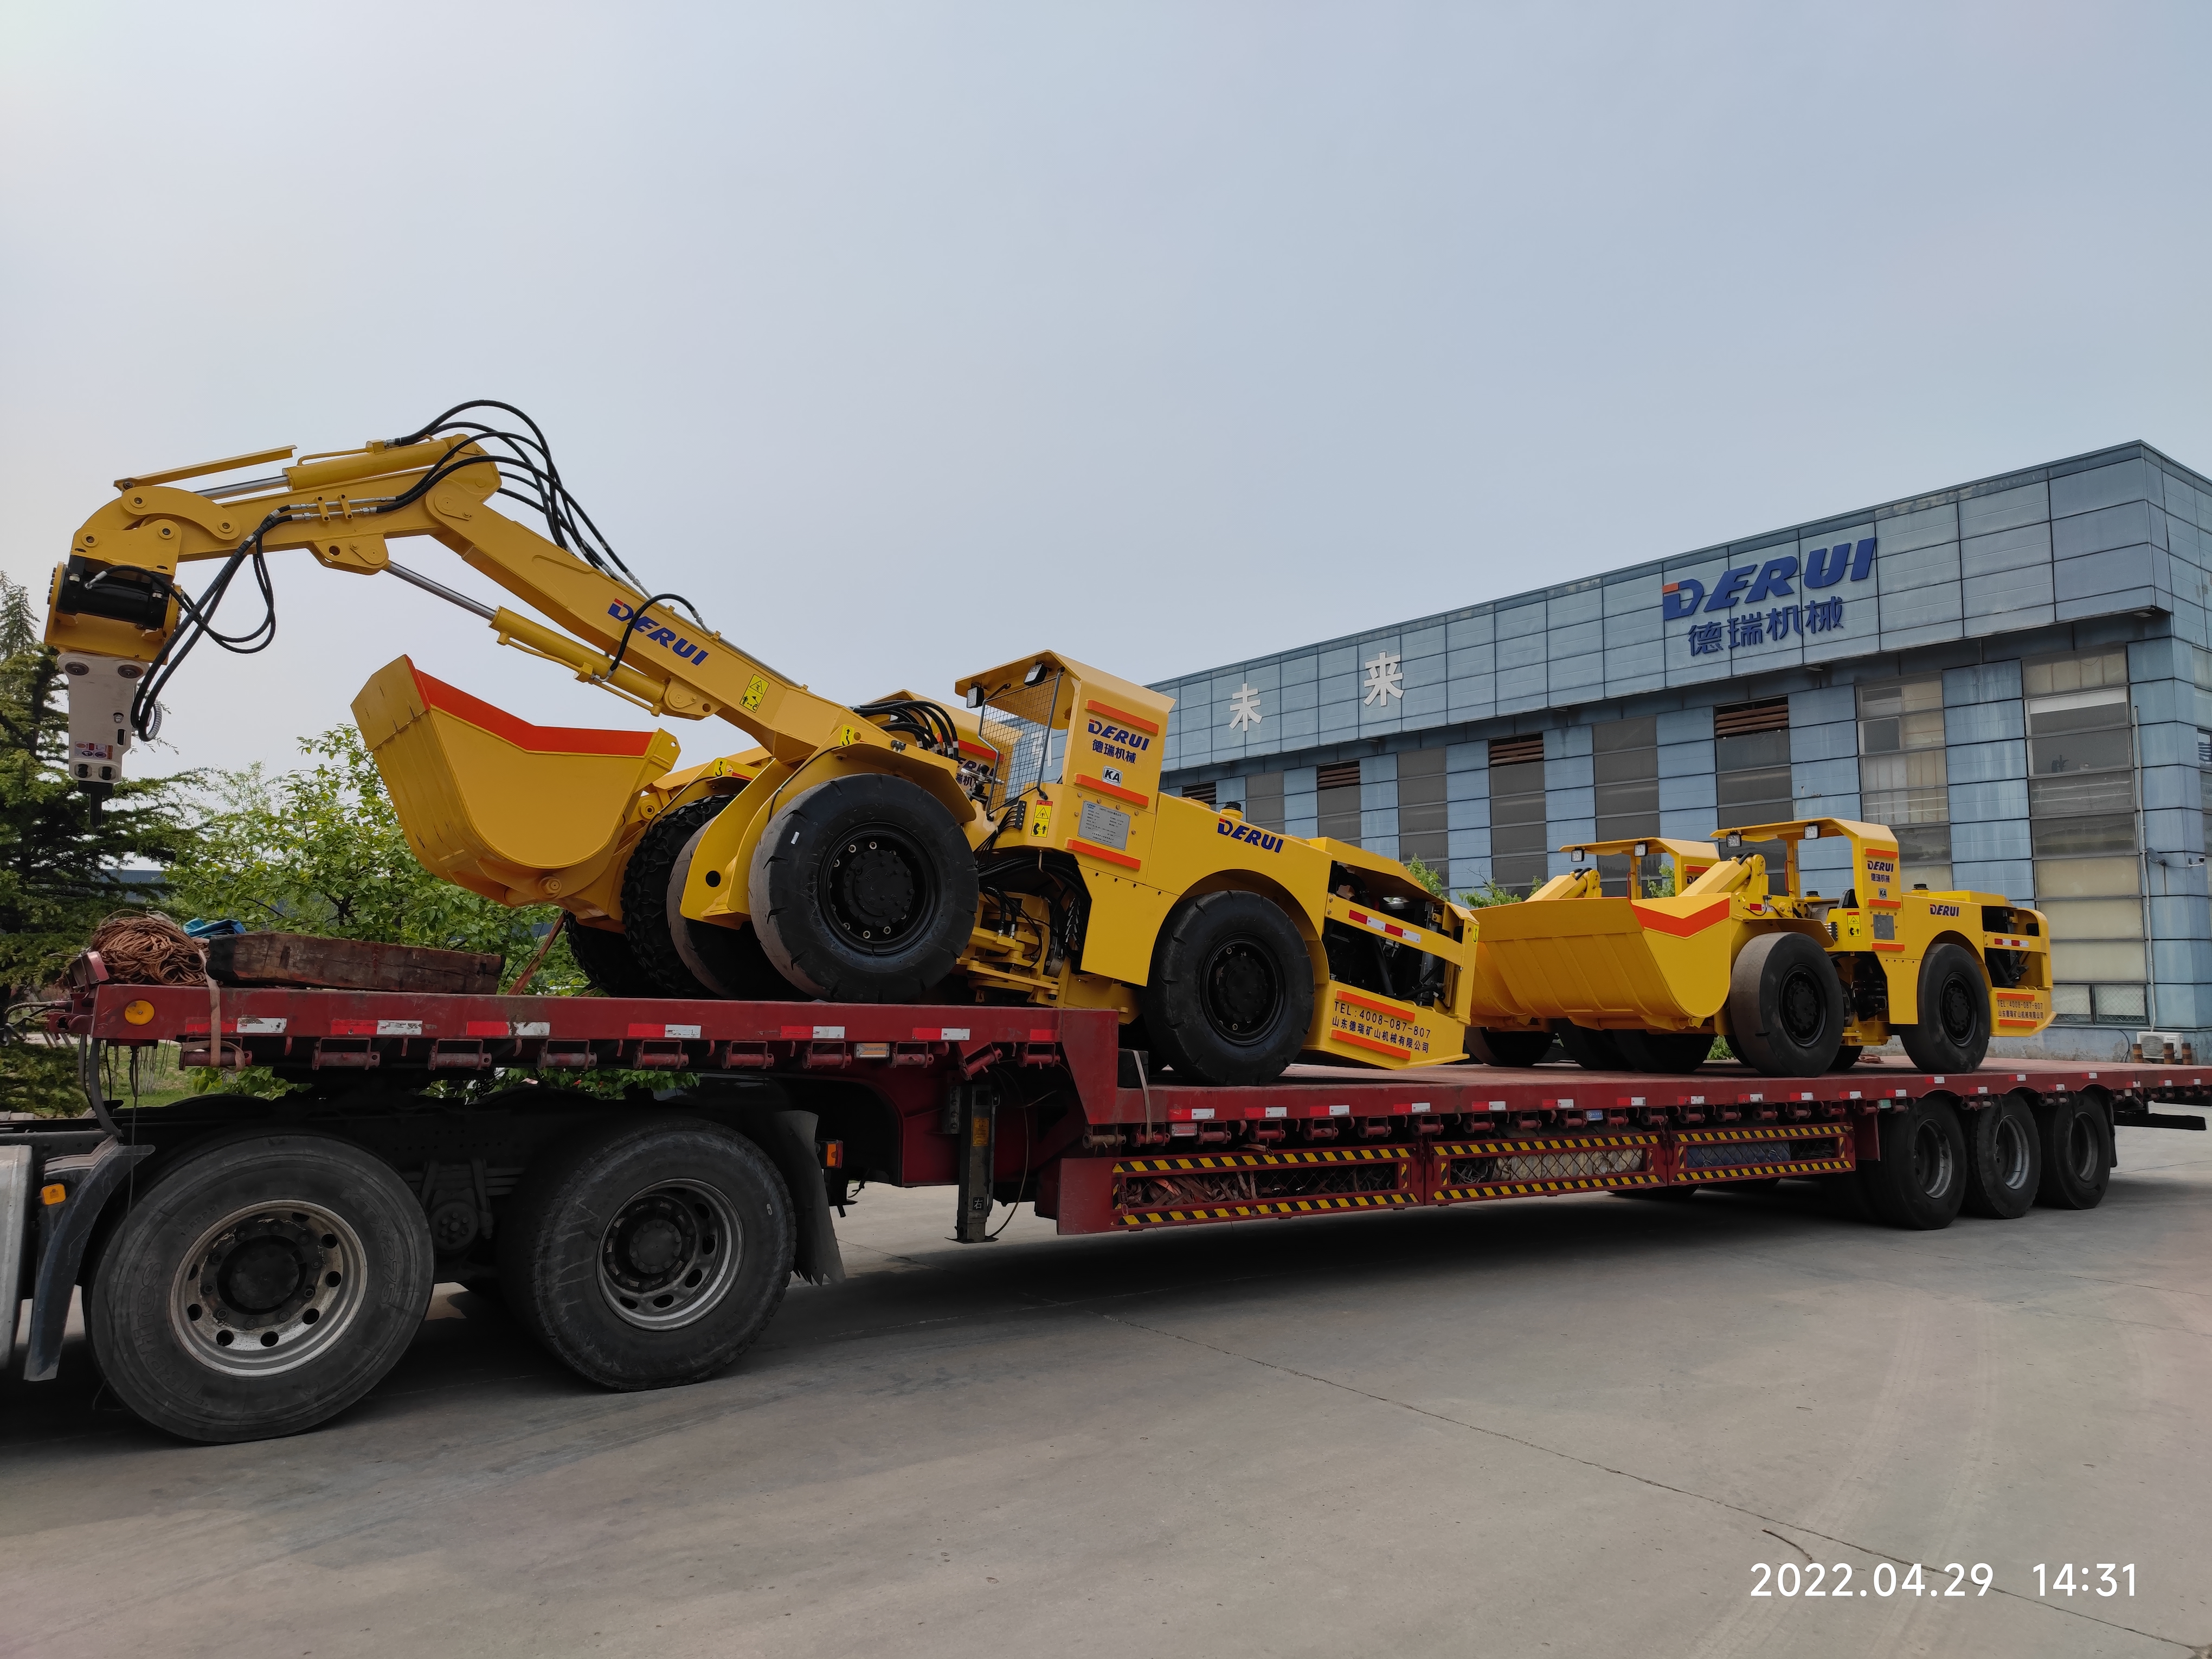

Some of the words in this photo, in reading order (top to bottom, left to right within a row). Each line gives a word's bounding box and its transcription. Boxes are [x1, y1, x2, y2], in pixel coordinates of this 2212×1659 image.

[1662, 537, 1876, 620] DERUI
[607, 598, 709, 666] DERUI
[1687, 596, 1843, 656] 德瑞机械
[1088, 719, 1150, 751] DERUI
[1092, 739, 1136, 764] 德瑞机械
[1104, 769, 1121, 783] KA
[1217, 818, 1284, 853] DERUI
[1867, 860, 1894, 872] DERUI
[1871, 873, 1890, 883] 德瑞机械
[1930, 904, 1959, 917] DERUI
[1332, 1015, 1429, 1053] 山东德瑞矿山机械有限公司
[974, 1198, 983, 1210] 右
